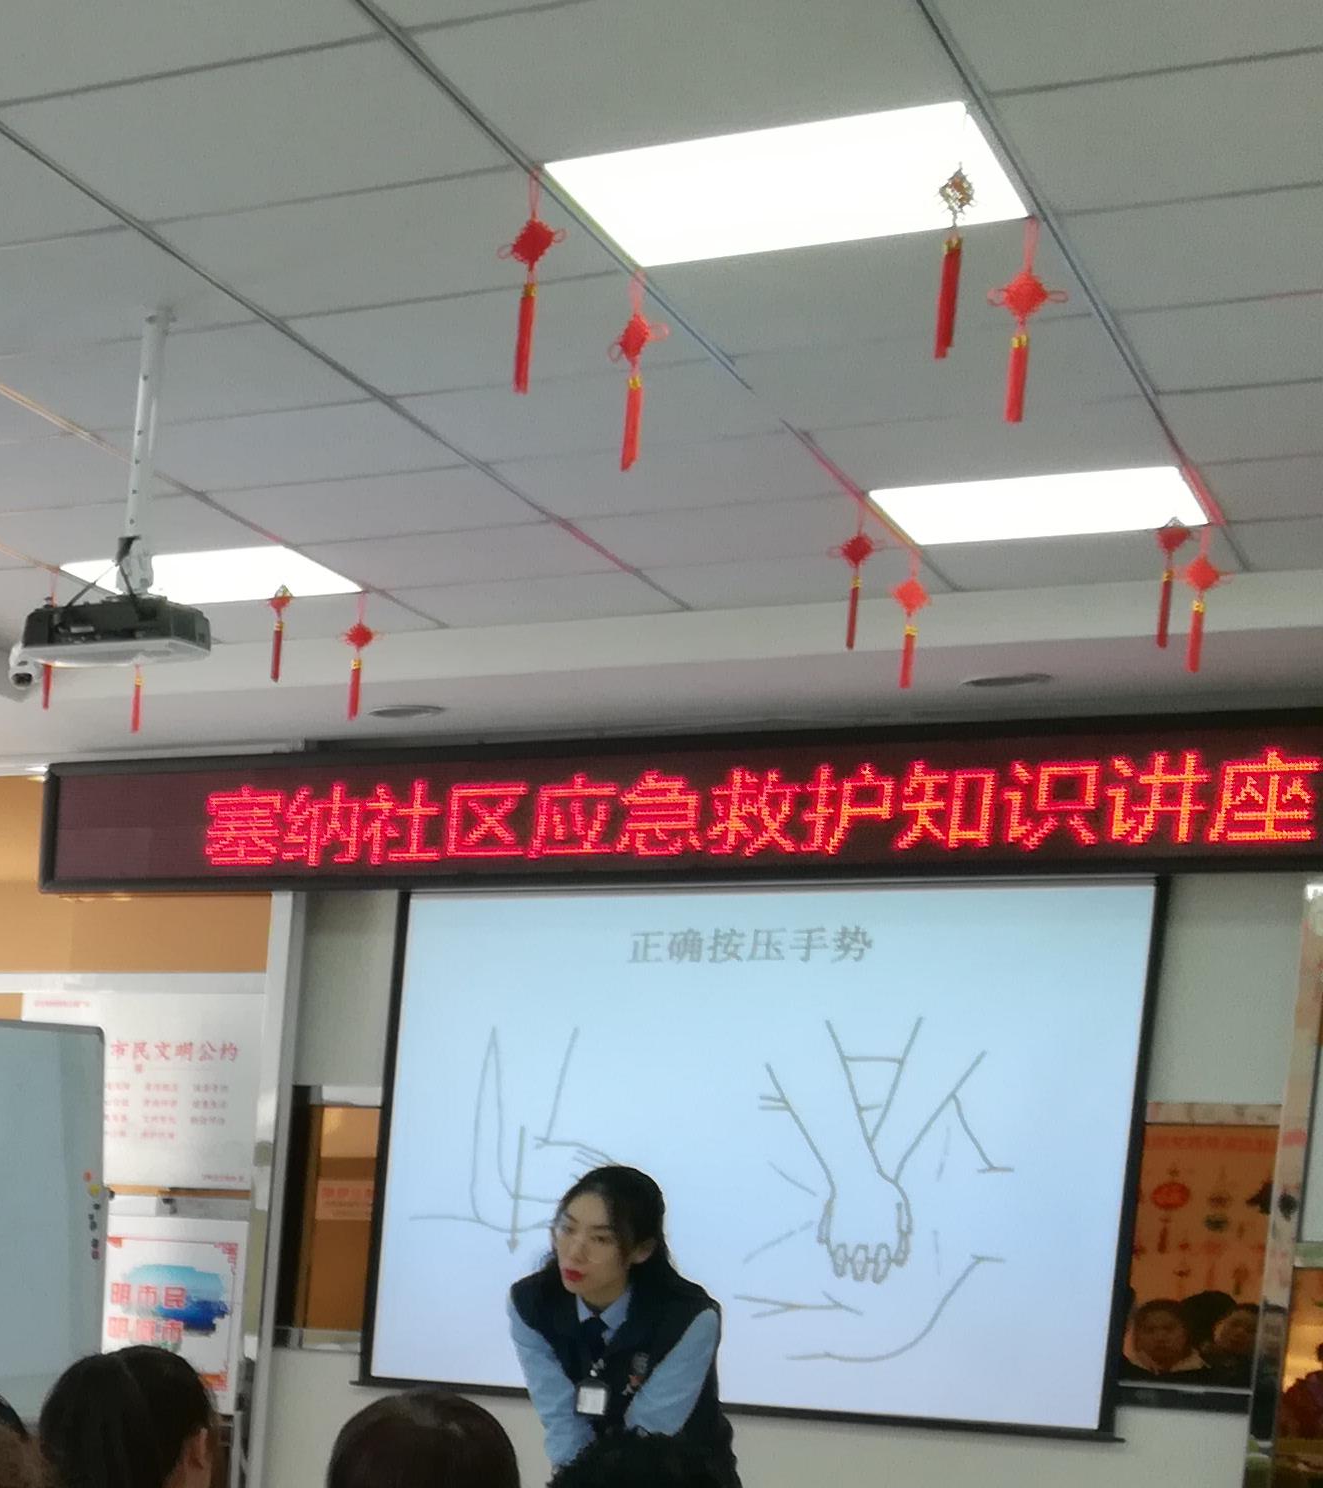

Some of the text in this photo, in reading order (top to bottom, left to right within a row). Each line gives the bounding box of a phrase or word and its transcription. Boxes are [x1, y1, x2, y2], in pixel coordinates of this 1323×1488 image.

[205, 746, 1322, 868] 塞纳社区应急救护知识讲座
[627, 925, 873, 964] 正确按压手势
[110, 1039, 239, 1063] 市民文明公约
